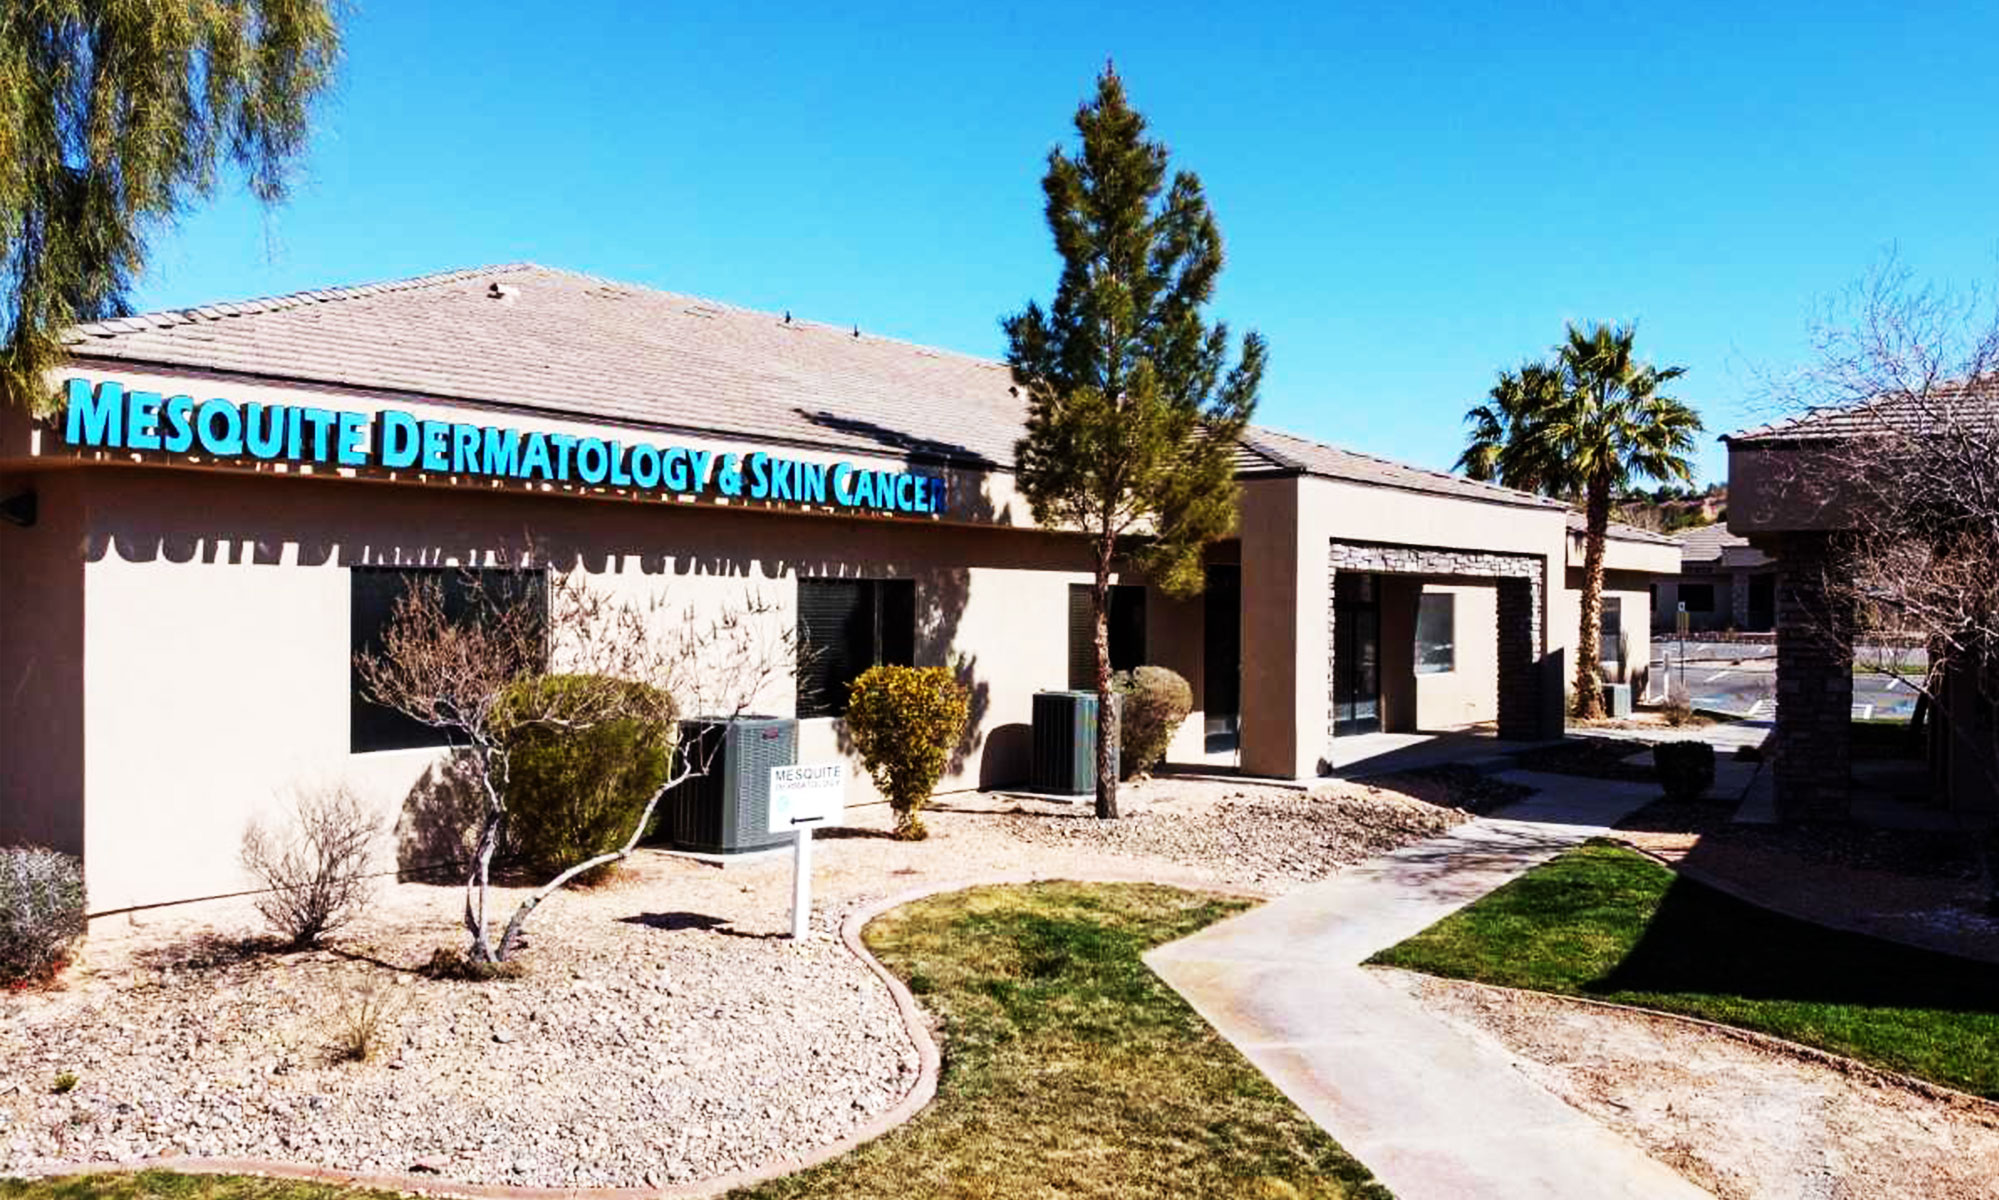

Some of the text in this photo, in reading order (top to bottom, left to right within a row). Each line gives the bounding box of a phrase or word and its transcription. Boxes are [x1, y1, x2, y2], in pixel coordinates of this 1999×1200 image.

[65, 378, 947, 513] MESQUITE DERMATOLOGY & SKIN CANCER
[775, 766, 841, 781] MESQUITE
